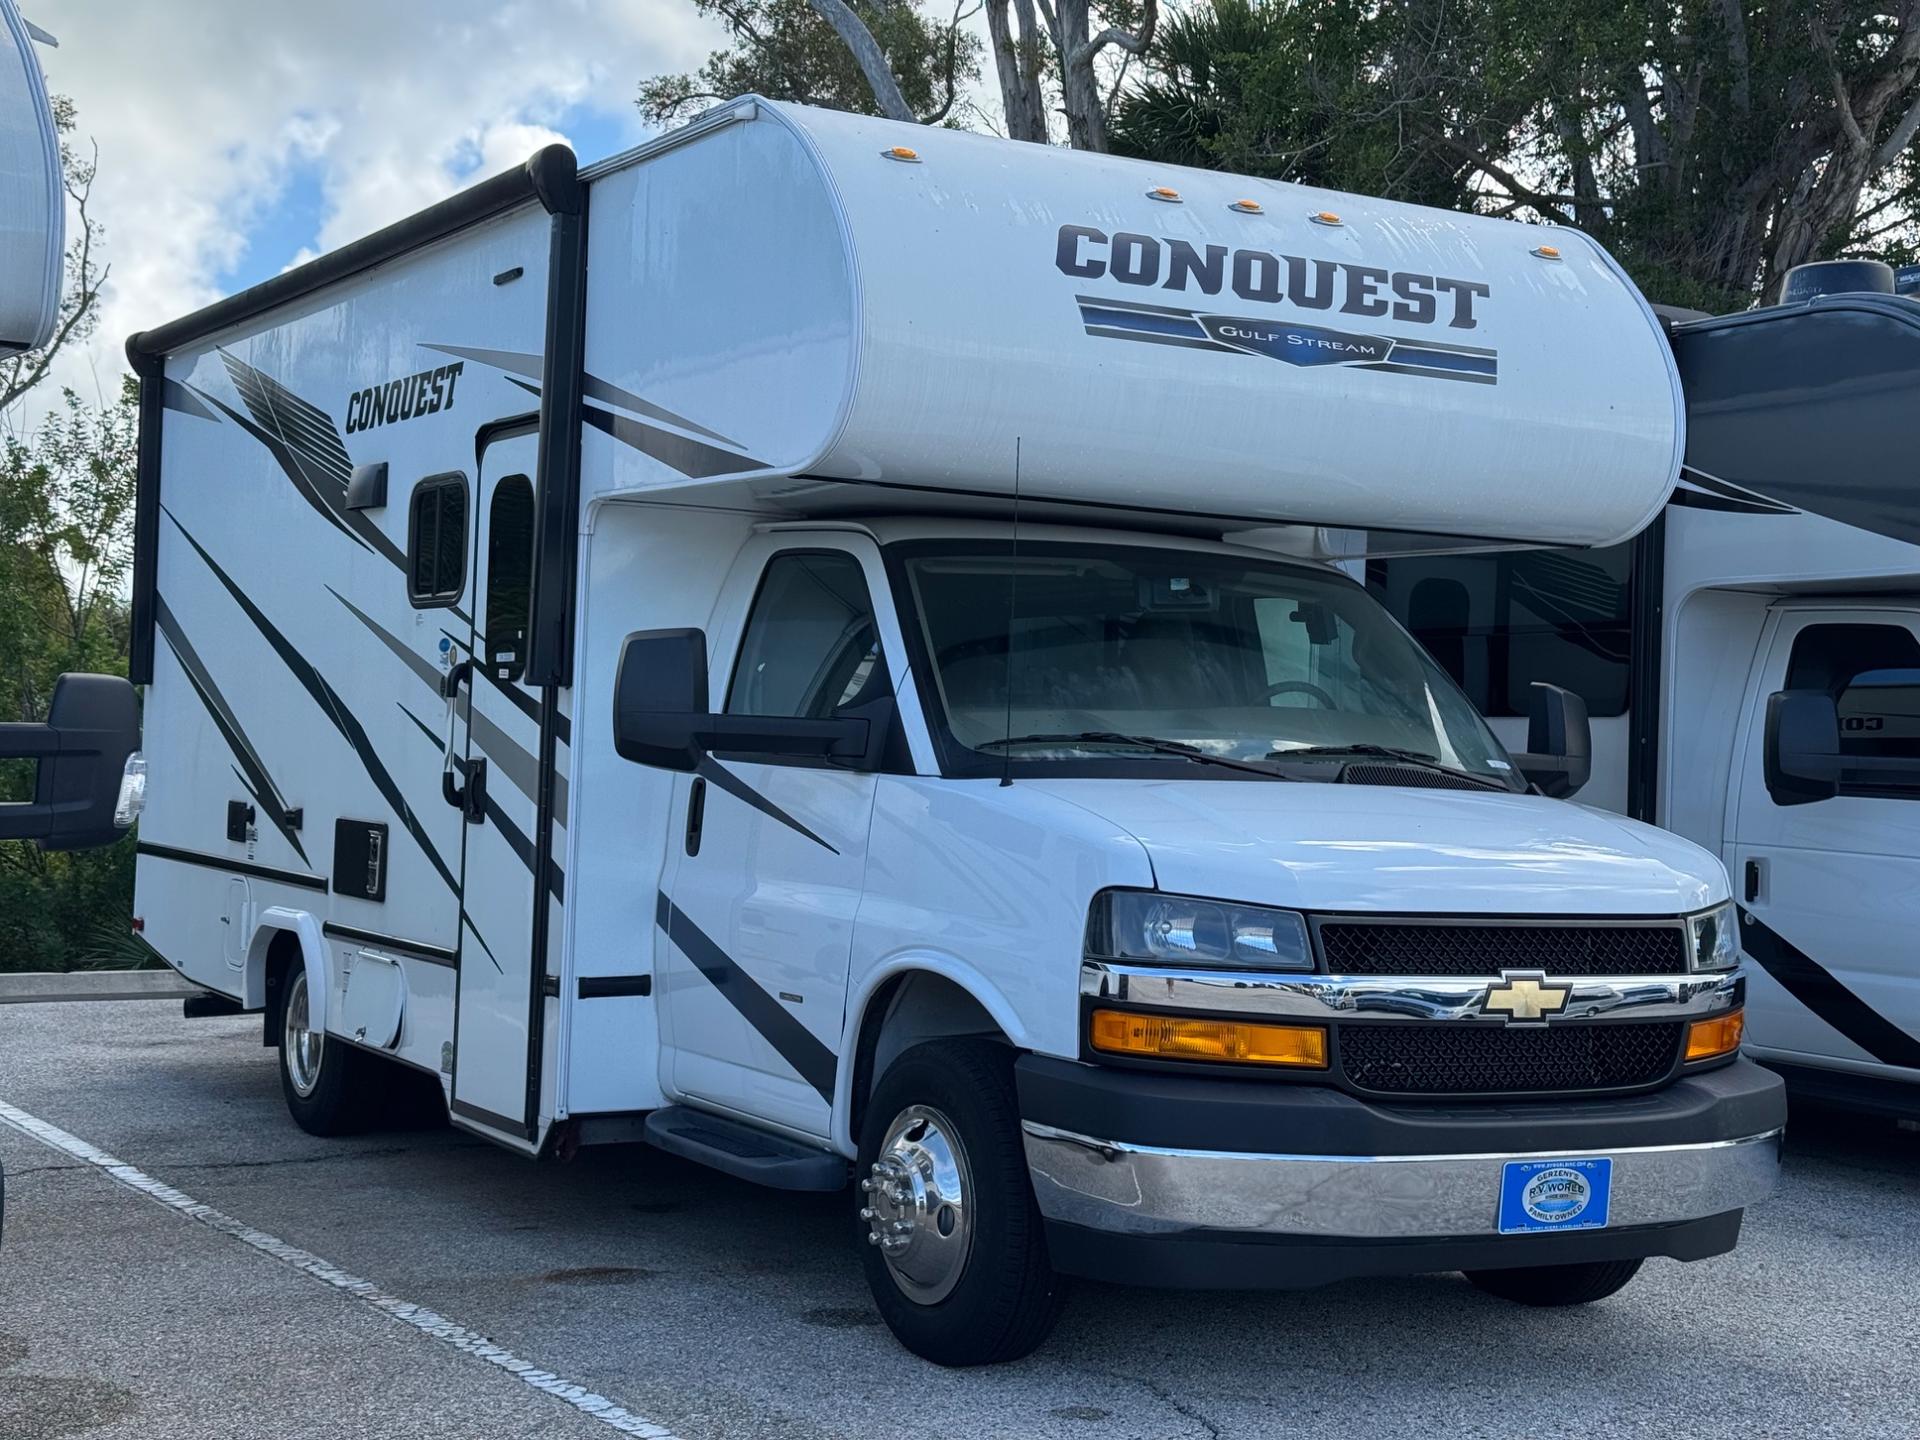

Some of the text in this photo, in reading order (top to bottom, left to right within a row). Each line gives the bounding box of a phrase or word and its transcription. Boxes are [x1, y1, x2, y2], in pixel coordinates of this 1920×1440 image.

[1055, 224, 1490, 329] CONQUEST
[345, 361, 464, 434] CONQUEST
[1537, 1169, 1579, 1182] GERZENY'S
[1548, 1182, 1585, 1194] WORLD
[1528, 1204, 1583, 1221] FAMILY OWNED
